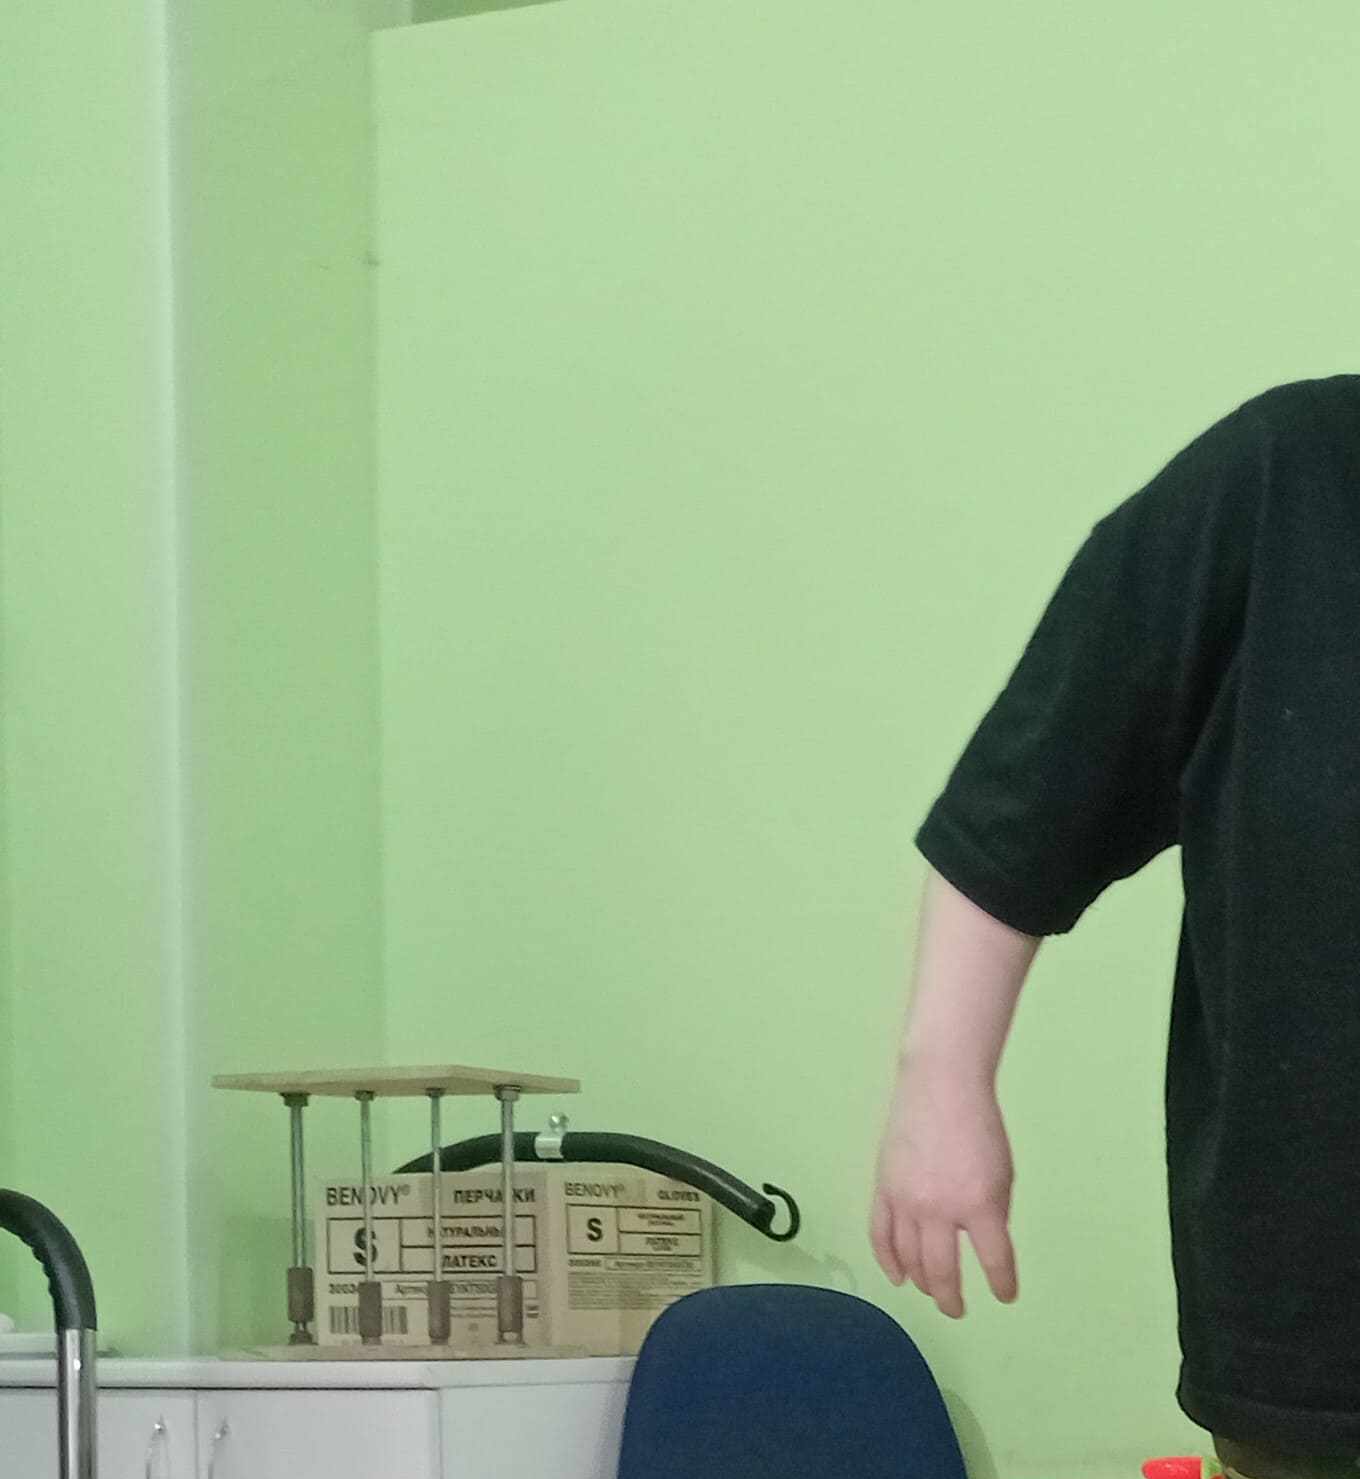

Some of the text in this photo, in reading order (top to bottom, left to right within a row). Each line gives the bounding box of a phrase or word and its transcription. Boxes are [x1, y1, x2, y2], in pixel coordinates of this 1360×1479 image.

[454, 1188, 536, 1205] ПЕРЧАКИ
[586, 1217, 604, 1242] S
[353, 1226, 378, 1267] S
